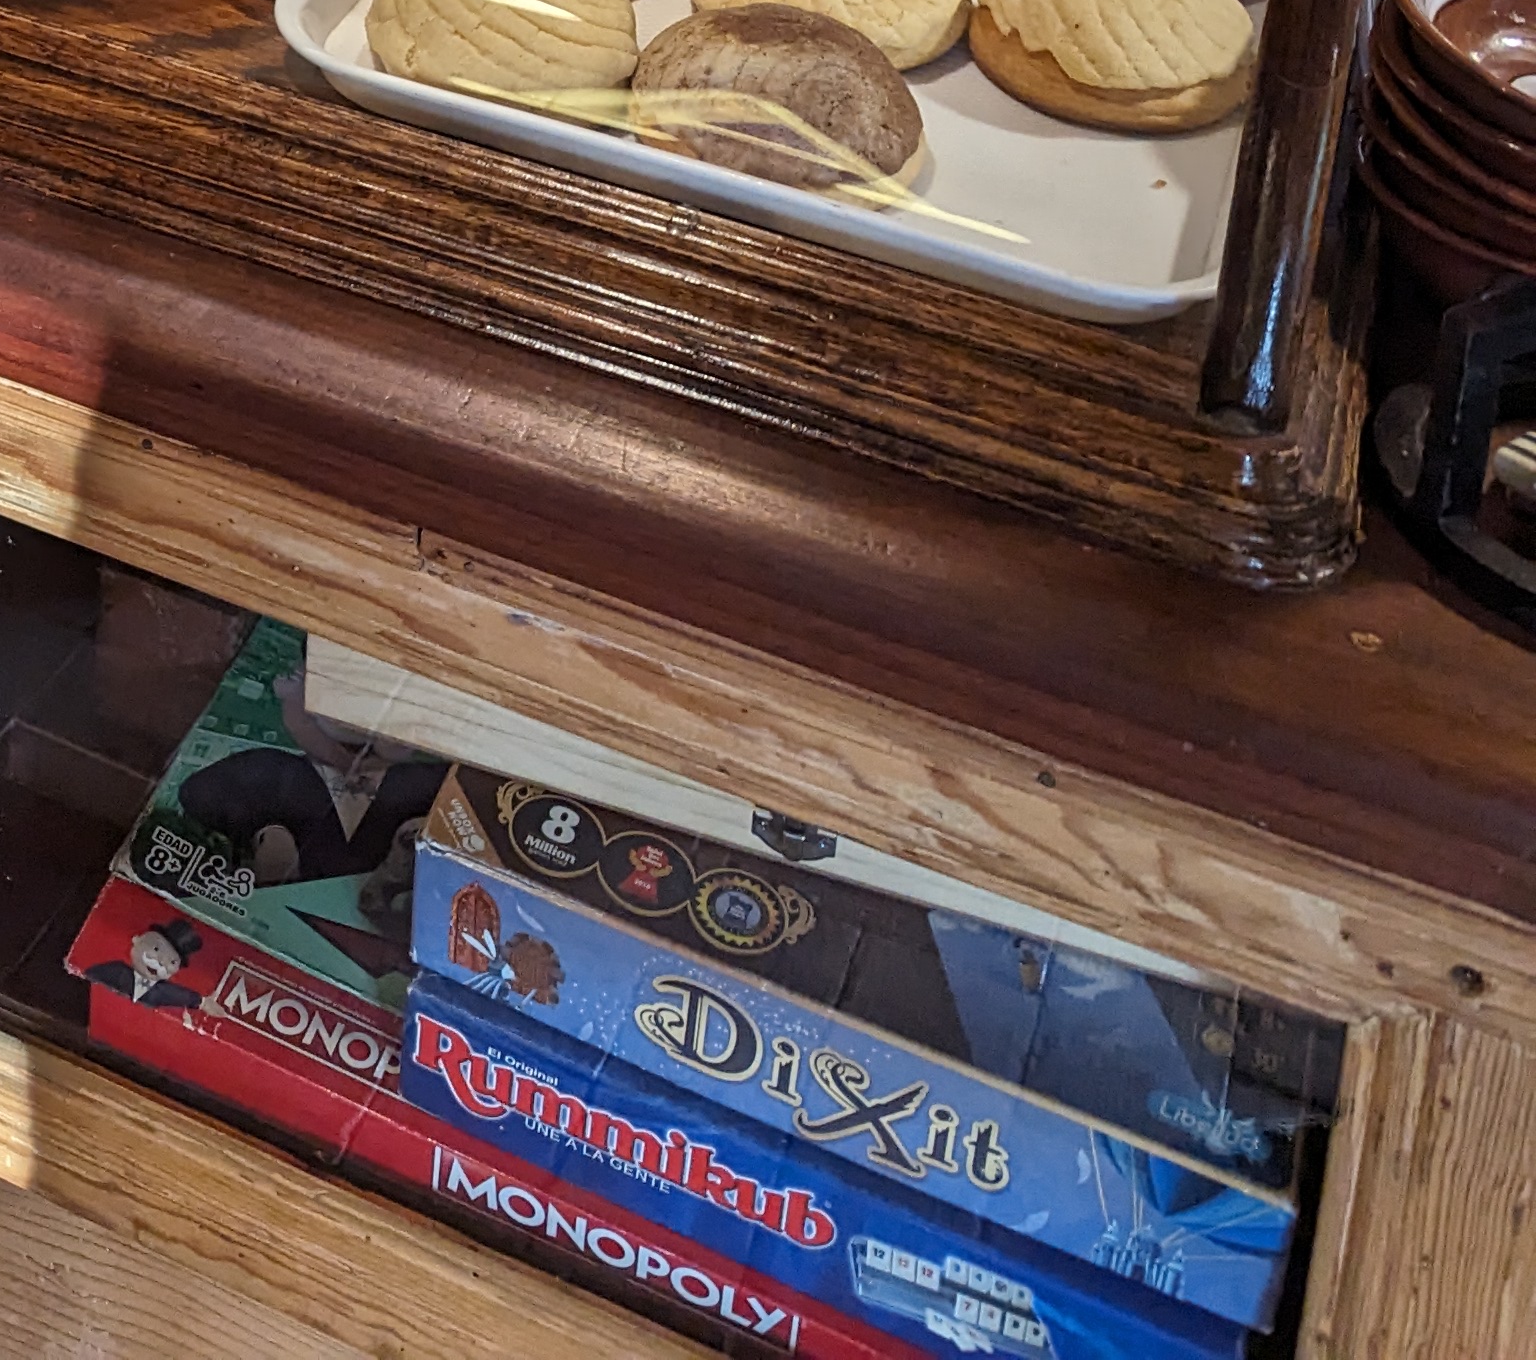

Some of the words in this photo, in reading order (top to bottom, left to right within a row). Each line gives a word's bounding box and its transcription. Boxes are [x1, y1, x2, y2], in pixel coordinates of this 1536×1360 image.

[154, 828, 192, 856] EDAD
[541, 805, 581, 844] 8
[146, 846, 180, 873] 8+
[524, 835, 576, 866] Million
[186, 882, 246, 917] JUGADORES
[224, 975, 401, 1080] MONOP
[487, 1046, 502, 1060] El
[504, 1055, 559, 1086] Original
[413, 1013, 838, 1250] Rummikub
[524, 1116, 561, 1143] UNE
[582, 1144, 605, 1164] LA
[609, 1157, 671, 1194] GENTE
[447, 1157, 787, 1335] MONOPOLY
